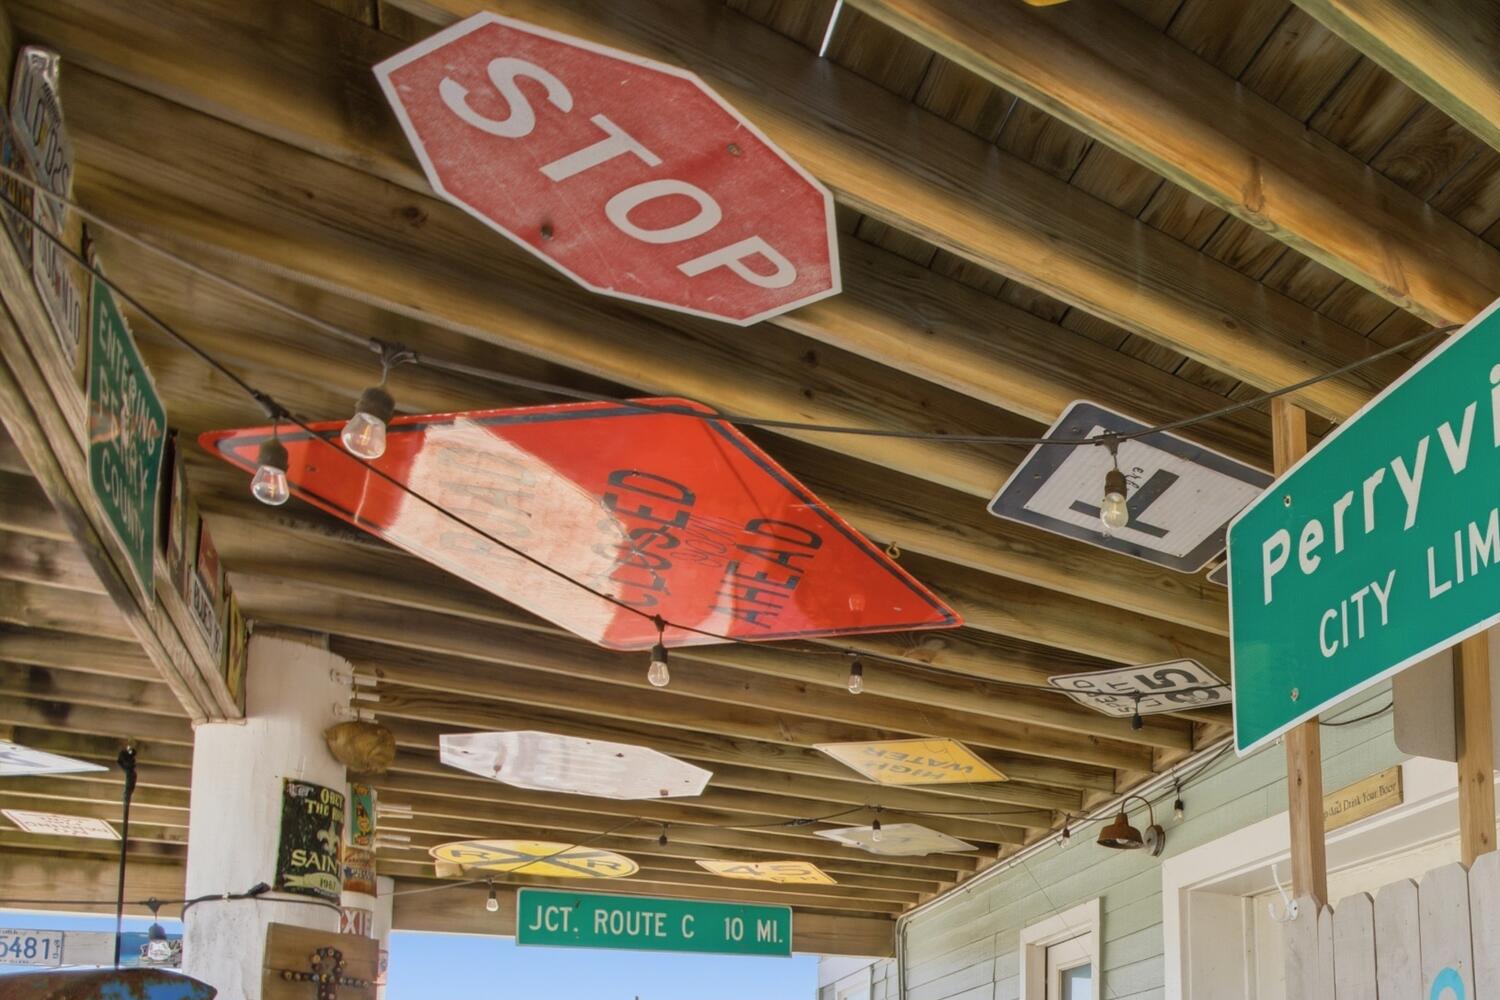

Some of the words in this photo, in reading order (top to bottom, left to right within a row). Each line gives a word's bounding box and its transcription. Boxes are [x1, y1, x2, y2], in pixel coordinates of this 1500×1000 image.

[439, 57, 797, 290] STOP
[99, 301, 158, 456] ENTERING
[101, 448, 145, 561] COUNTY
[594, 469, 697, 608] CLOSED
[707, 518, 823, 630] AHEAD
[1318, 569, 1396, 659] CITY
[1072, 679, 1136, 713] SPEED
[1105, 681, 1163, 708] LIIT
[863, 746, 974, 775] WATER
[863, 761, 945, 780] HIGH
[528, 904, 579, 933] JCT.
[594, 909, 668, 937] ROUTE
[681, 914, 695, 939] C
[724, 916, 744, 942] 10
[756, 918, 784, 944] MI.
